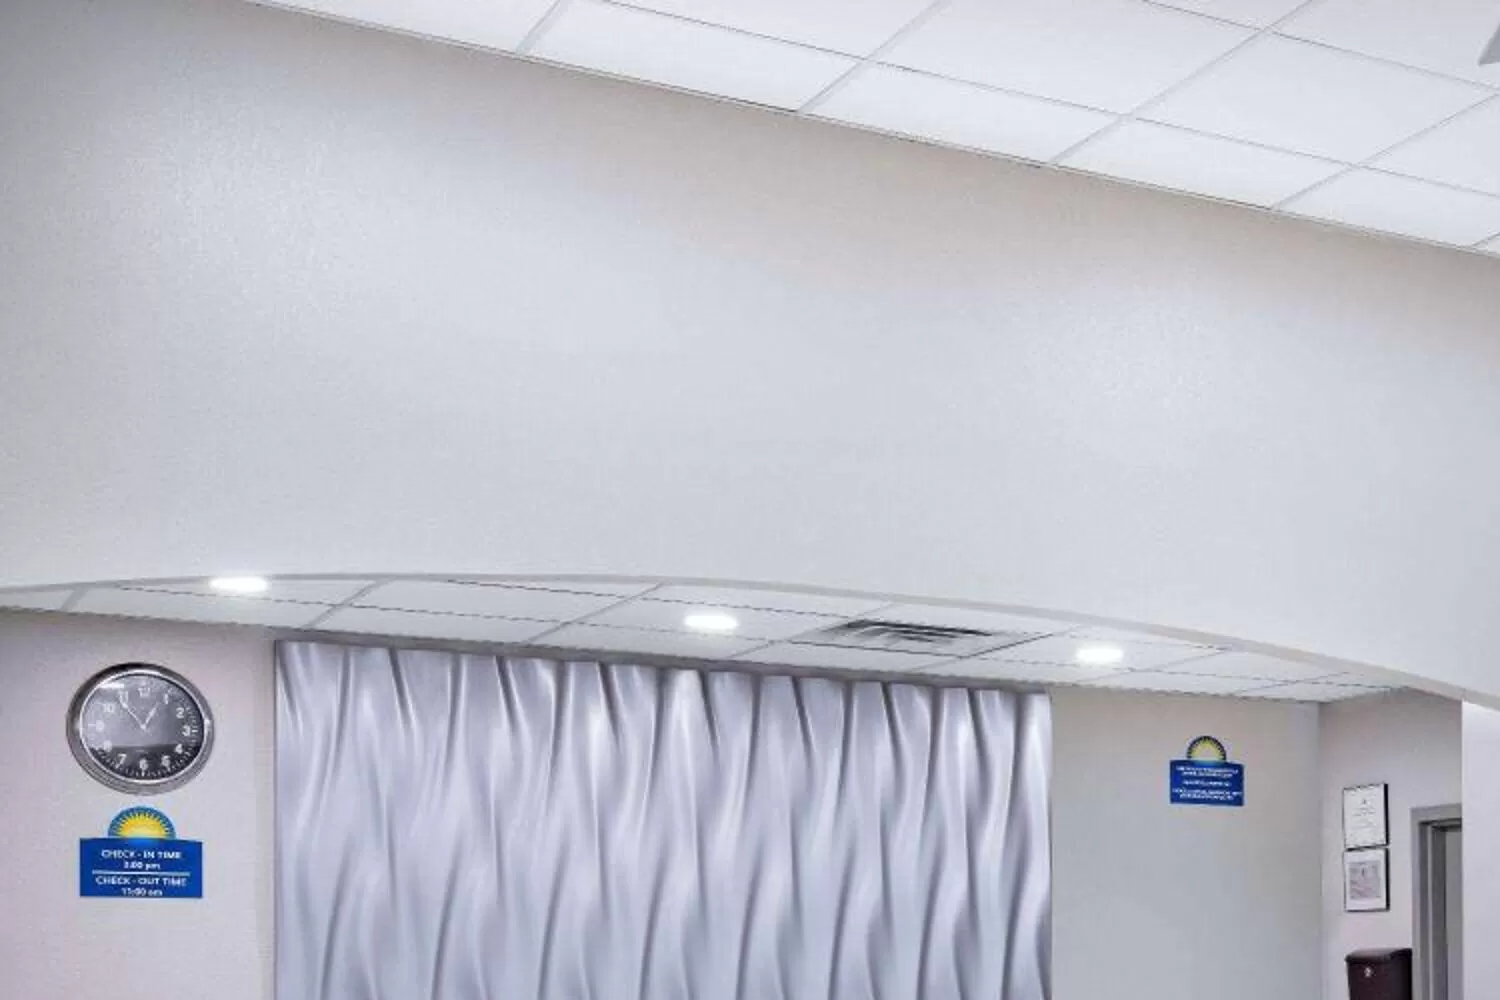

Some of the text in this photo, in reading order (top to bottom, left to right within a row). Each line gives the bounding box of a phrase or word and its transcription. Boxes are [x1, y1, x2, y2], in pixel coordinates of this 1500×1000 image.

[176, 707, 185, 719] 2
[182, 725, 191, 737] 3
[174, 743, 183, 754] 4
[118, 753, 127, 765] 7
[139, 757, 148, 770] 6
[101, 848, 135, 859] CHECK
[157, 850, 182, 859] TIME
[95, 875, 131, 885] CHECK
[138, 877, 160, 885] OUT
[162, 877, 187, 887] TIME
